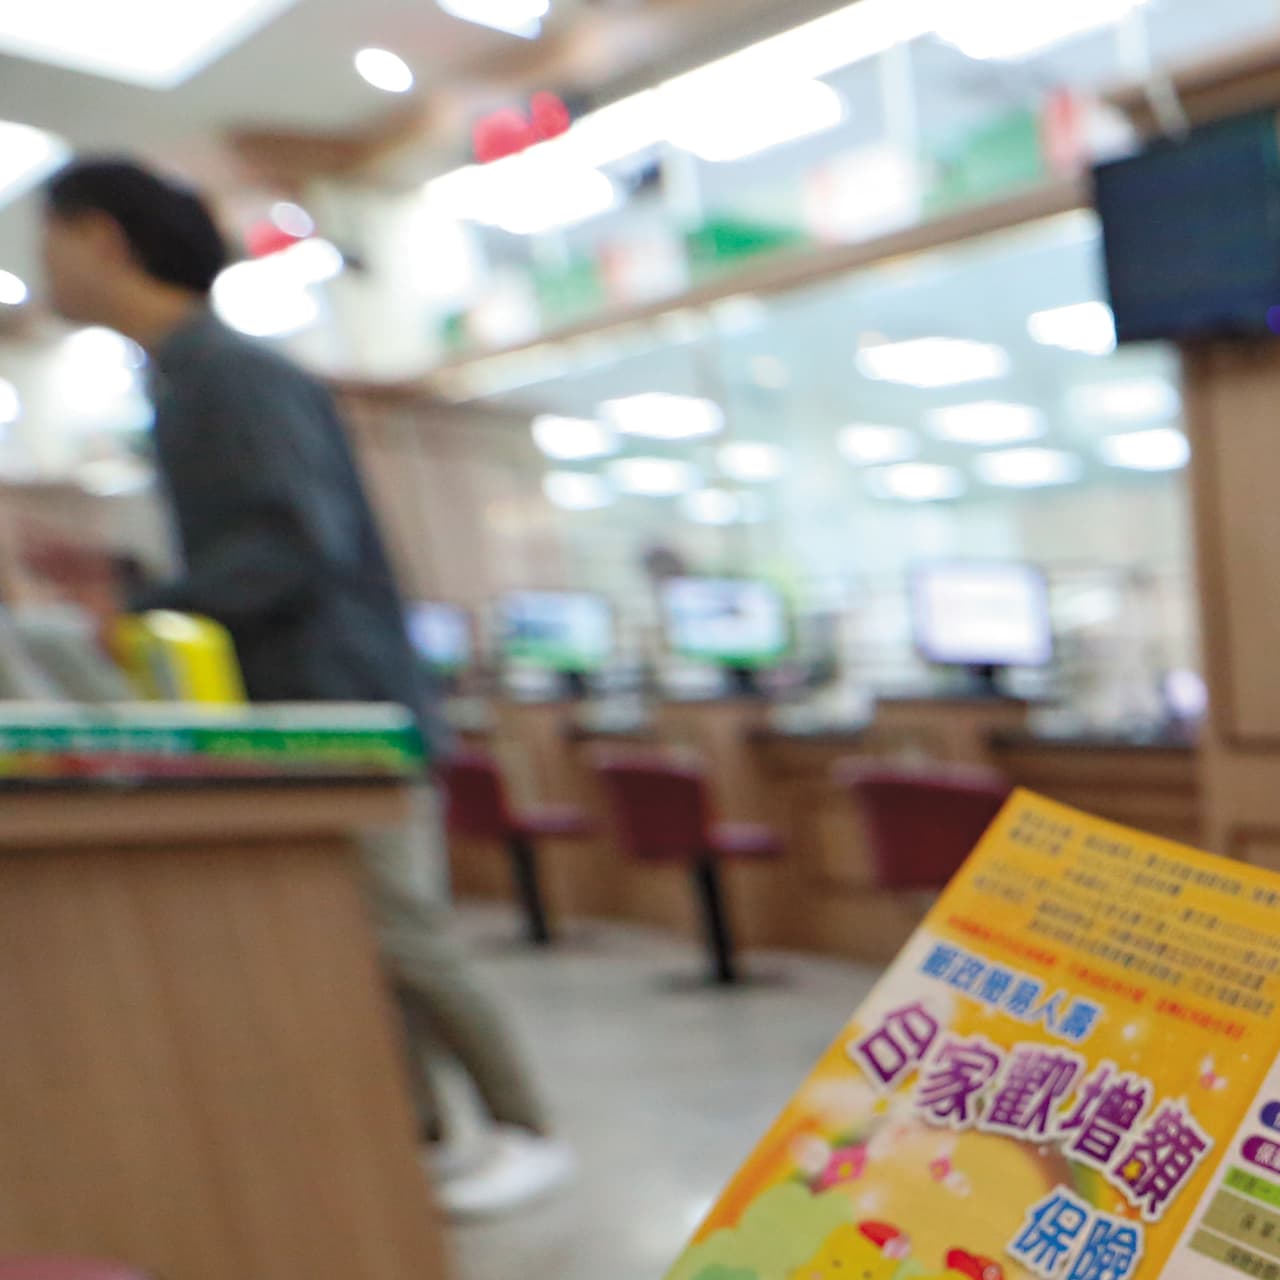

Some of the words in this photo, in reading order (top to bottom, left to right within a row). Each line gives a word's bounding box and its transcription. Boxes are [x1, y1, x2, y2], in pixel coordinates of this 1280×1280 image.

[918, 942, 1101, 1043] 郵政簡易人壽
[853, 1002, 1209, 1214] 合家歡增額
